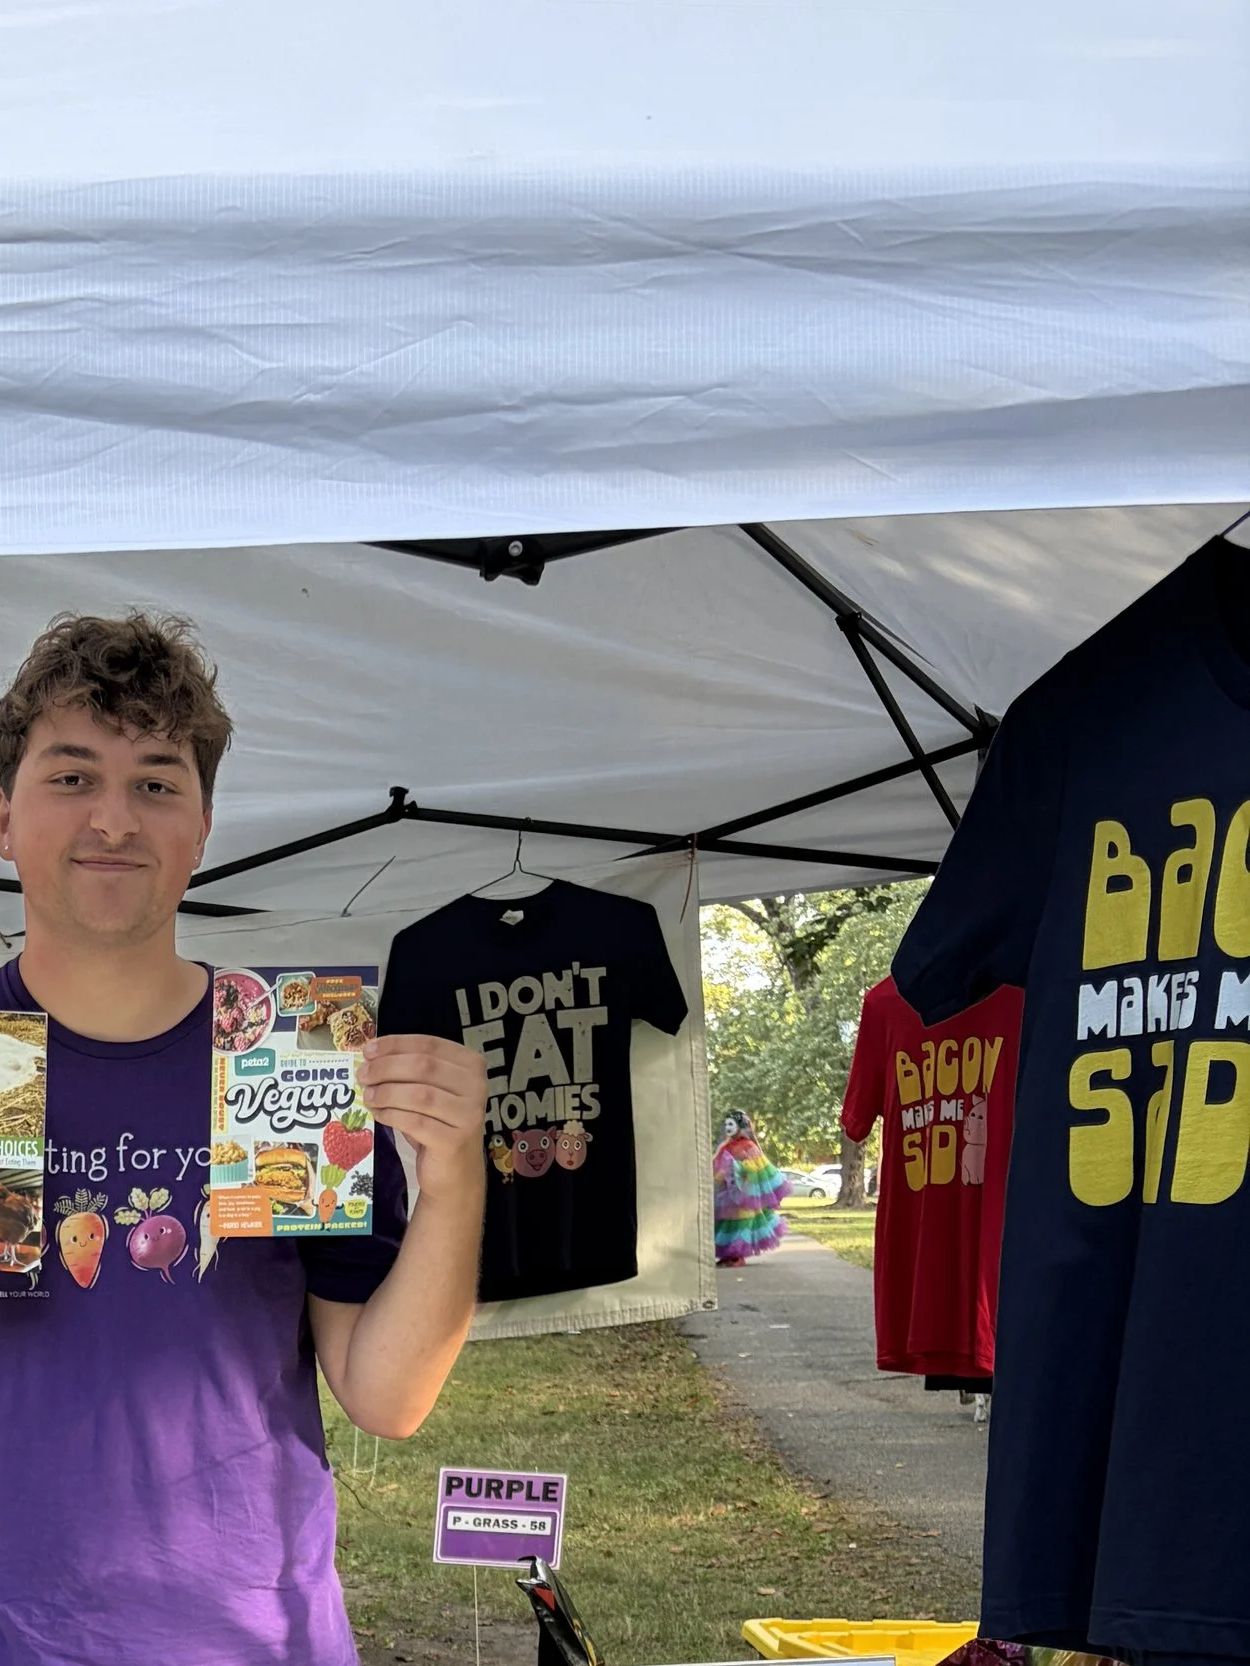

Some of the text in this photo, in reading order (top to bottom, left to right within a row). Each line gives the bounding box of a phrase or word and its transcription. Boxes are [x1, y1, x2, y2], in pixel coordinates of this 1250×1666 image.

[455, 961, 606, 1026] I DON'T
[241, 1056, 270, 1068] peta2
[462, 1006, 608, 1096] EAT
[280, 1068, 349, 1083] GOING
[225, 1077, 355, 1133] Vegan
[484, 1084, 601, 1135] HOMIES
[940, 1099, 964, 1122] ME
[116, 1132, 167, 1172] for
[444, 1475, 559, 1502] PURPLE
[452, 1516, 462, 1526] P
[472, 1517, 518, 1531] GRASS
[530, 1520, 547, 1531] 58
